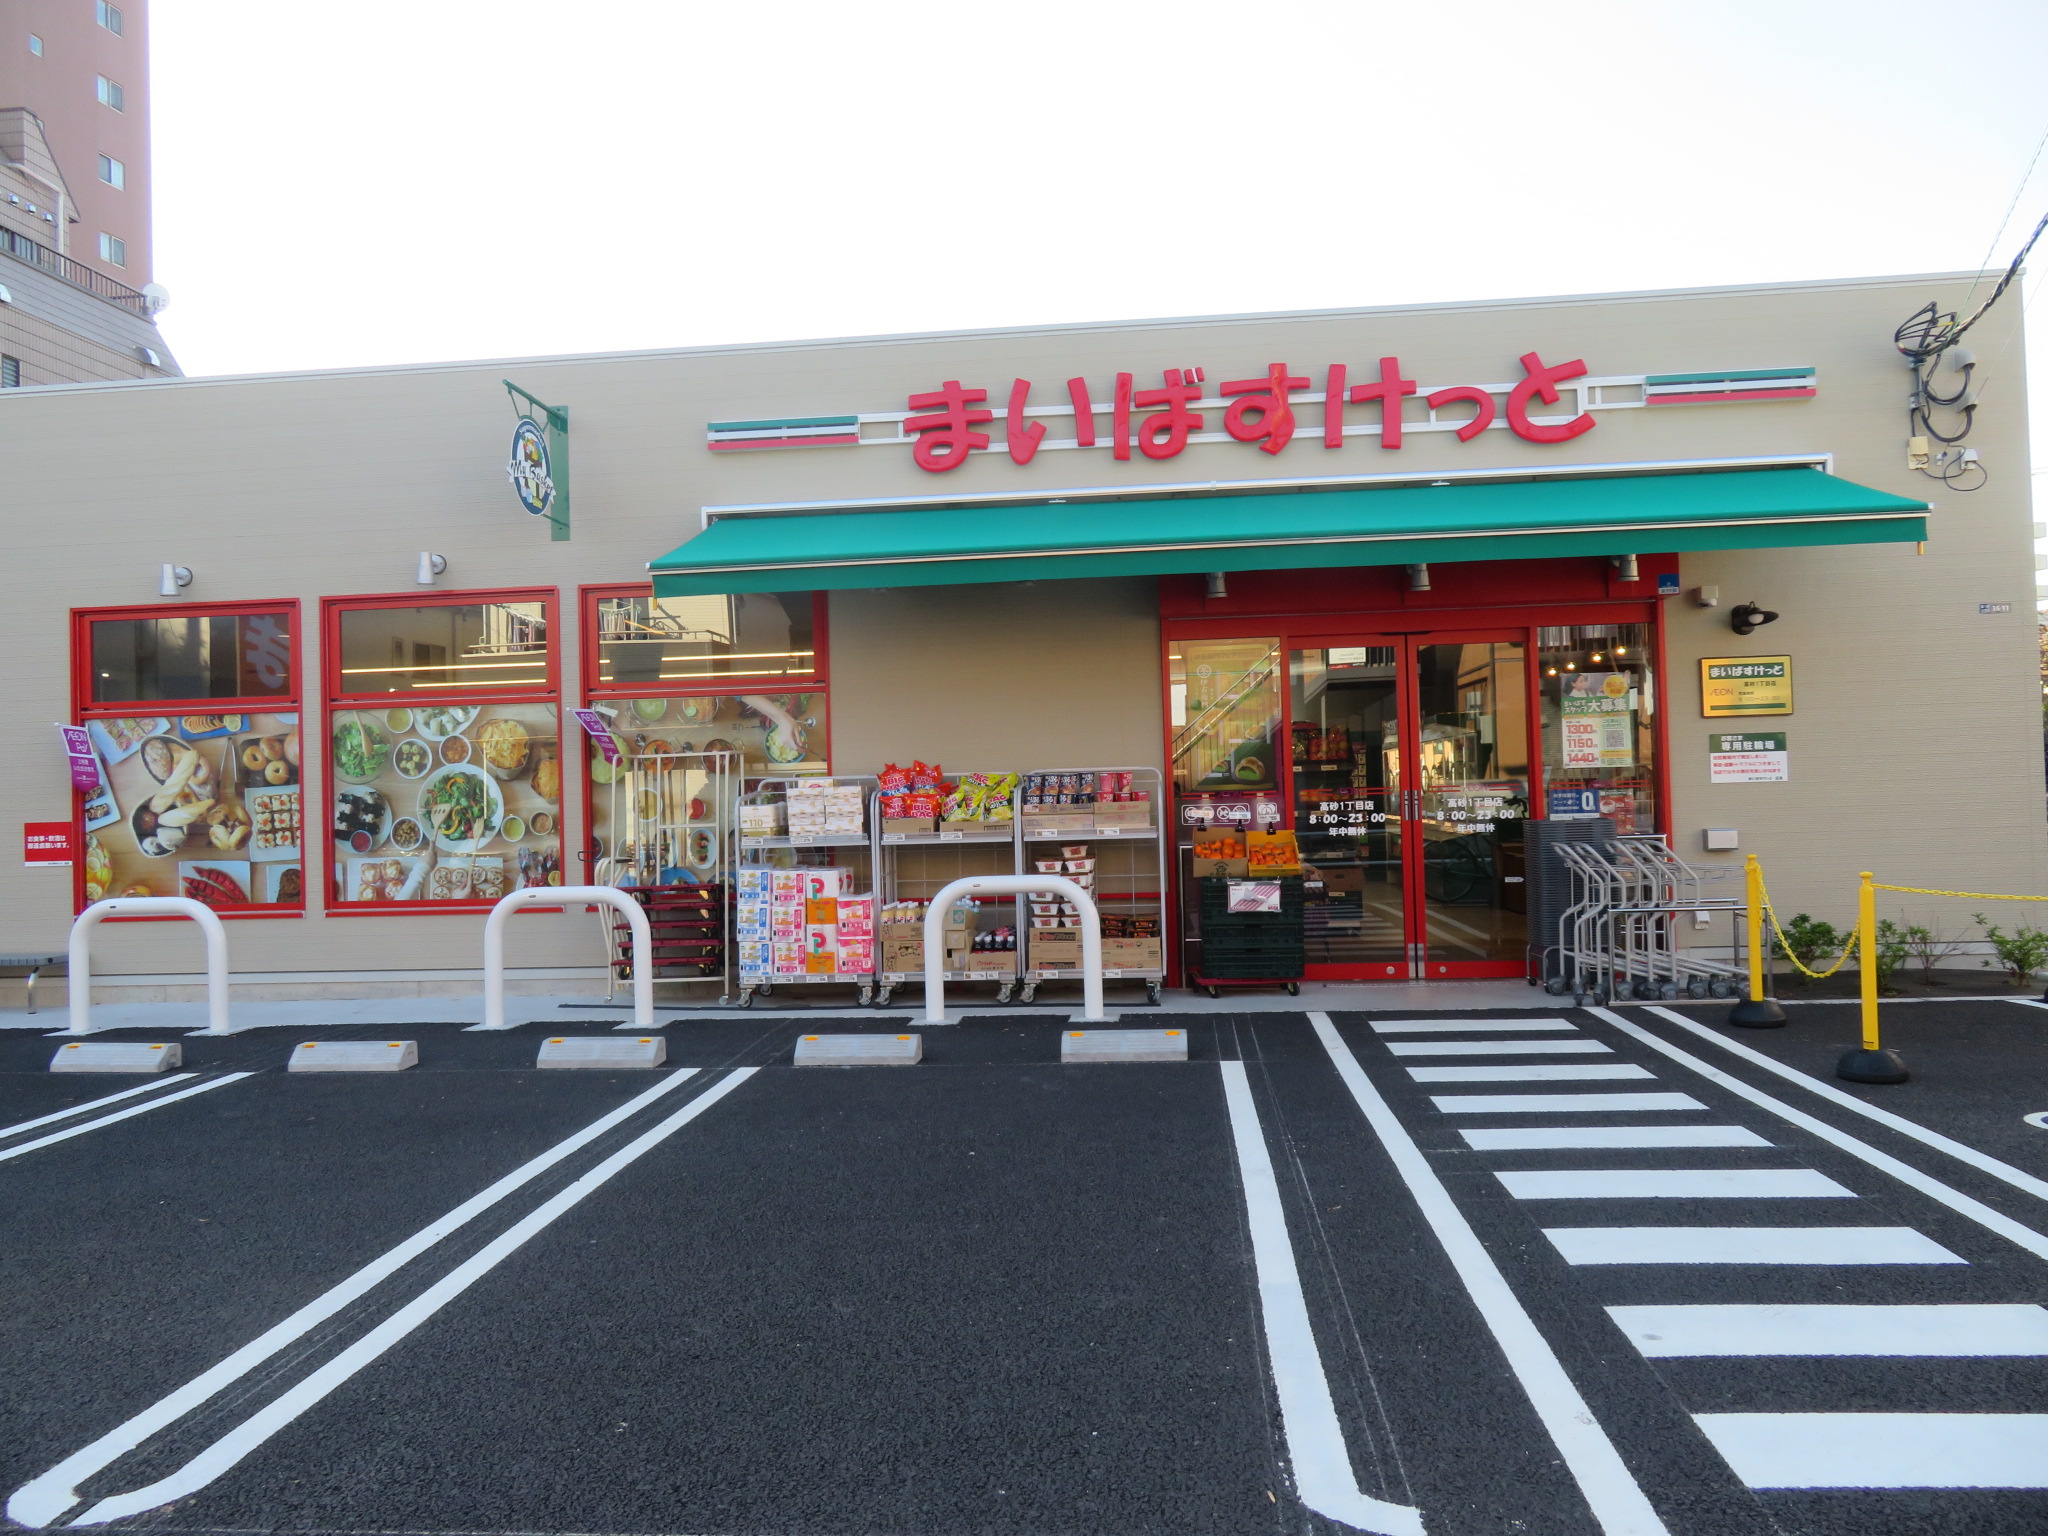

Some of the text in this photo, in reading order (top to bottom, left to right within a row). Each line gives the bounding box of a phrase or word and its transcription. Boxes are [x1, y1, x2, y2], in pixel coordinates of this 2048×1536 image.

[904, 352, 1596, 473] まいばすけっと
[510, 460, 553, 492] My Basket
[1710, 665, 1783, 677] まいばすけっと
[1587, 698, 1627, 713] 大募集
[1721, 740, 1775, 751] 専用駐輪場
[887, 776, 904, 785] BIG
[912, 803, 931, 811] BIG
[1319, 801, 1374, 811] 高砂1丁目店
[1447, 797, 1503, 807] 高砂1丁目店
[748, 818, 763, 827] 110
[1457, 823, 1496, 832] 年中無休
[1328, 827, 1367, 836] 年中無休
